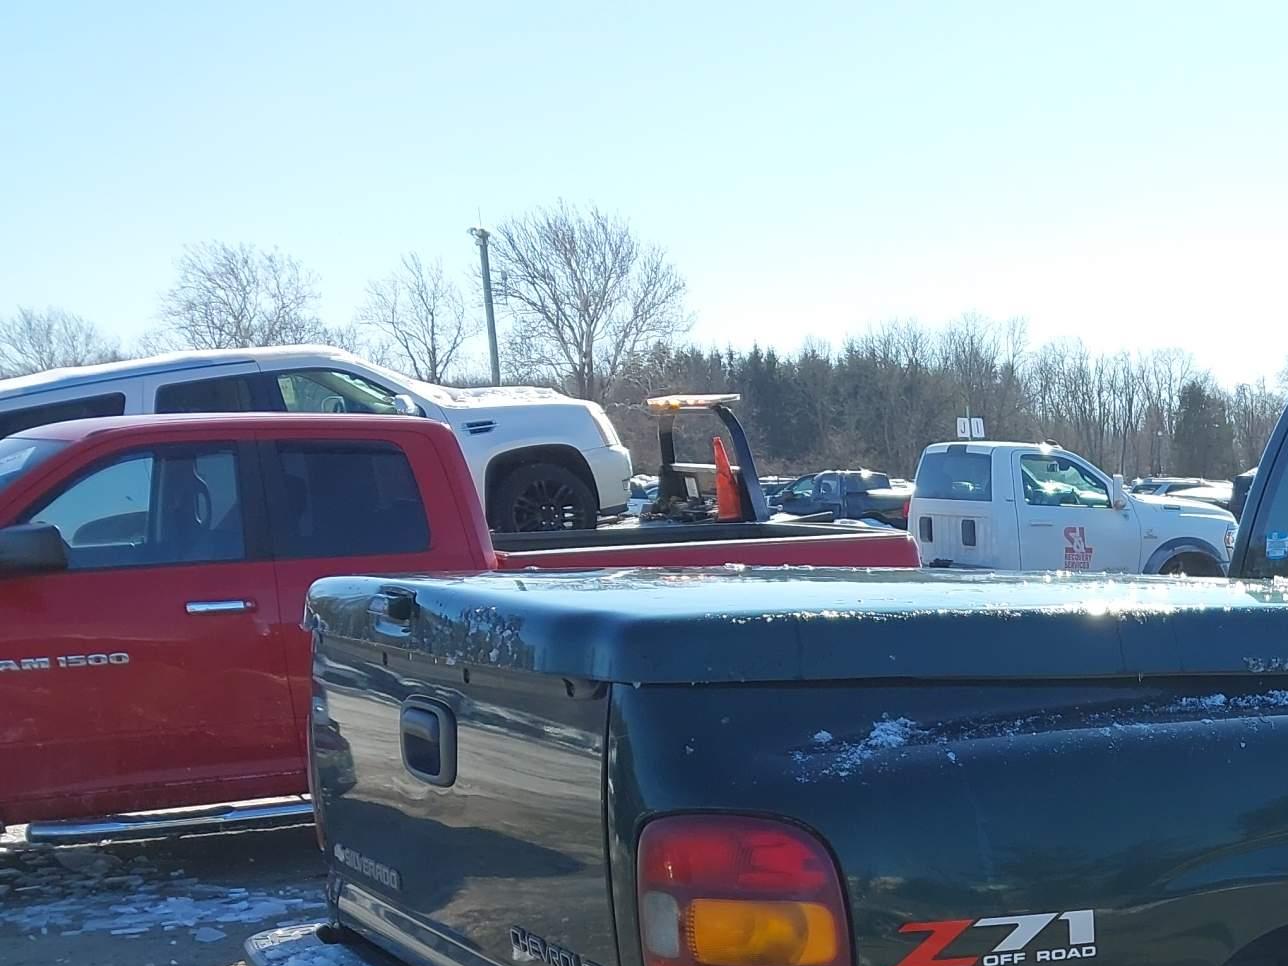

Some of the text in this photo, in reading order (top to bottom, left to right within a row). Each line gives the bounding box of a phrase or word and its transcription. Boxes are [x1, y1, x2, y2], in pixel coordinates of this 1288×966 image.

[1064, 553, 1093, 561] RECOVERY
[0, 652, 129, 672] AM 1500
[344, 847, 400, 889] SILVERADO
[1036, 946, 1097, 963] ROAD
